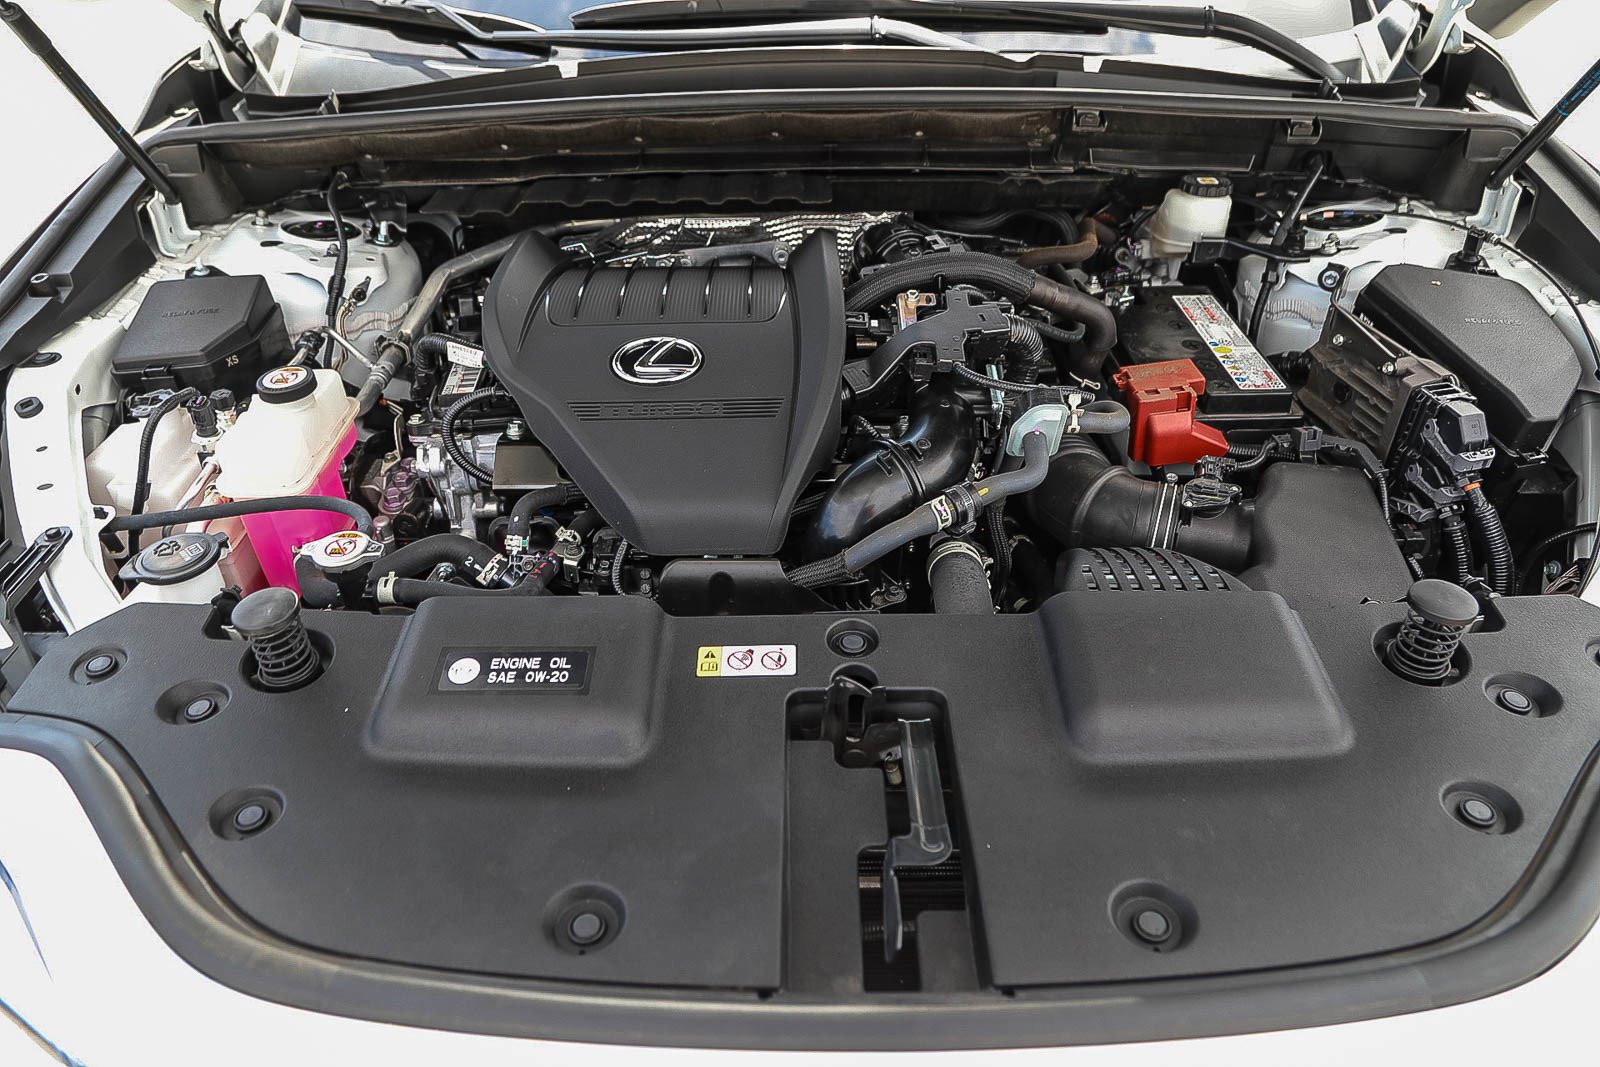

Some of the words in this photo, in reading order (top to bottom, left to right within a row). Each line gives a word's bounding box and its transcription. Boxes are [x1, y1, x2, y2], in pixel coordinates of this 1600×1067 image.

[604, 401, 721, 417] TURBO
[490, 657, 542, 670] ENGINE
[549, 657, 572, 669] OIL
[487, 671, 517, 684] SAE
[525, 671, 570, 683] 0W-20
